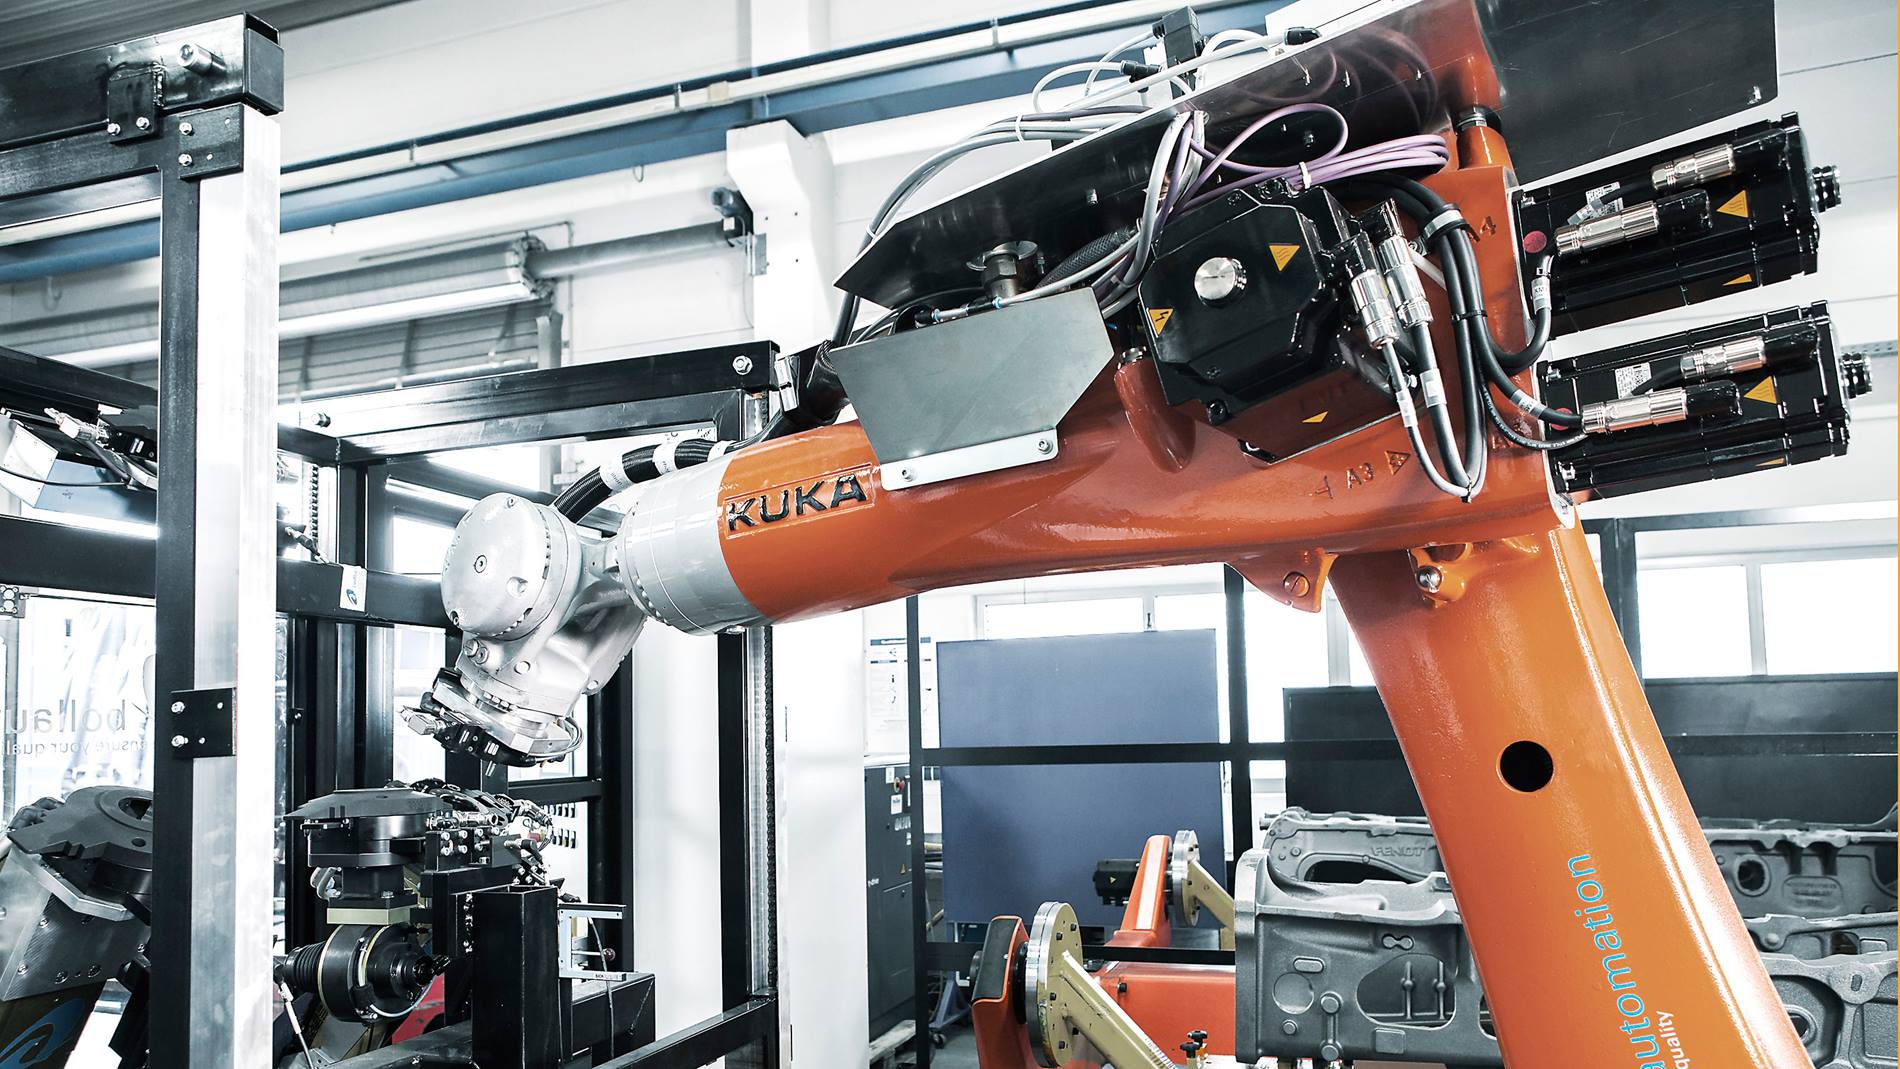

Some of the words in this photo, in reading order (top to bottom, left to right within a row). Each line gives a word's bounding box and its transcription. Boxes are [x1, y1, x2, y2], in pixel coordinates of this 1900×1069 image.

[1346, 462, 1375, 489] A3
[728, 473, 867, 531] KUKA
[1371, 846, 1426, 857] FENDT
